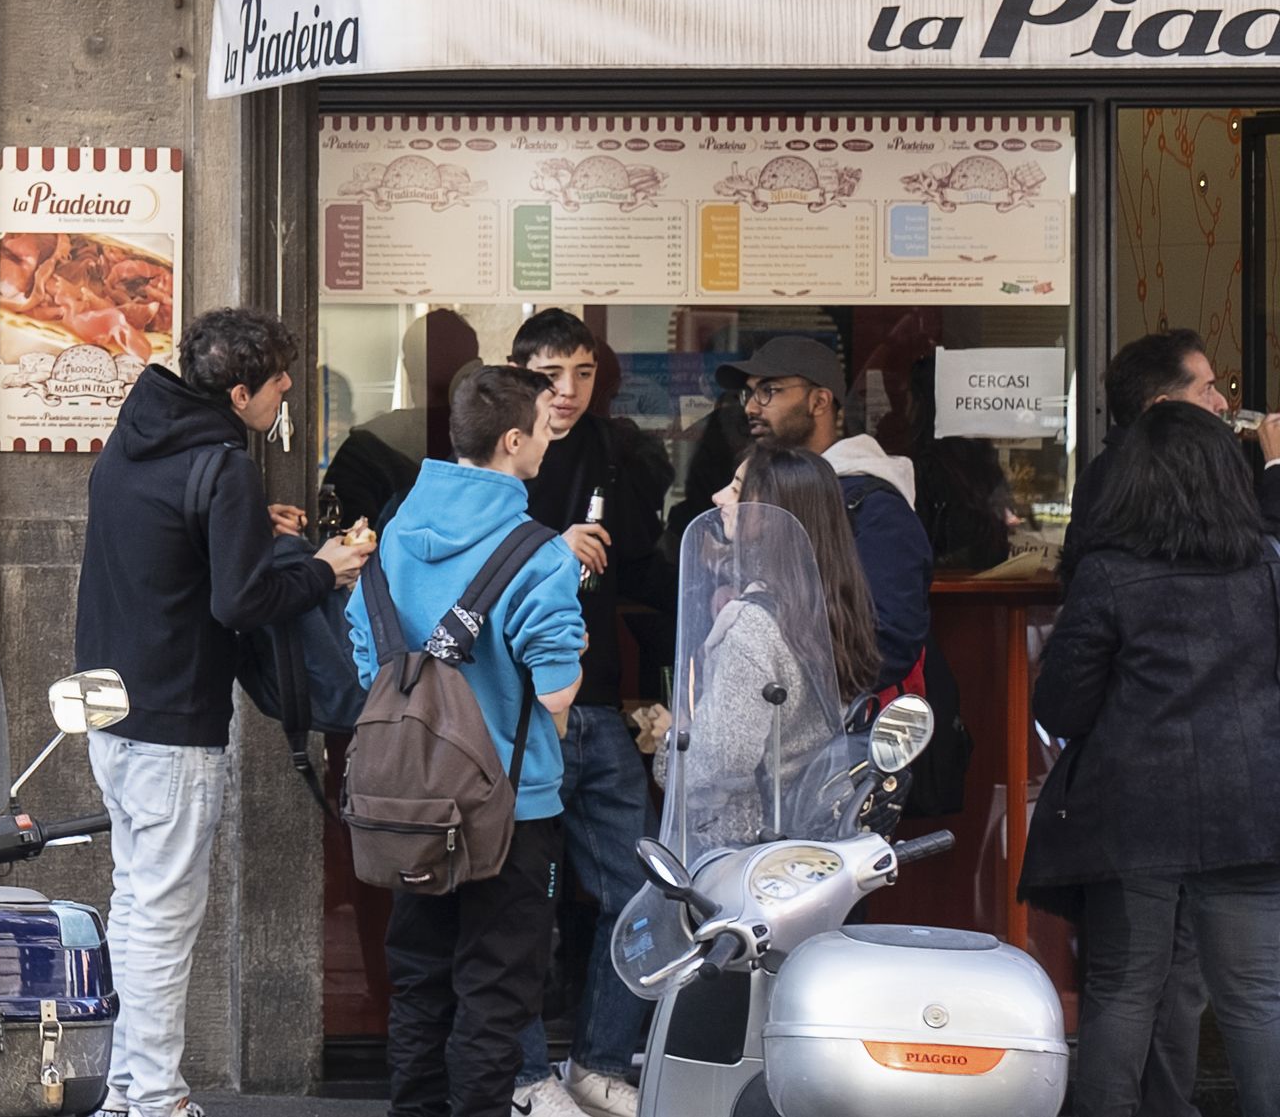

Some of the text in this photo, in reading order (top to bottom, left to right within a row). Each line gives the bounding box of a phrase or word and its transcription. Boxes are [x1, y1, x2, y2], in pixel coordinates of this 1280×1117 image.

[867, 5, 964, 52] la
[224, 42, 239, 84] la
[328, 135, 370, 150] Piadeina
[516, 136, 558, 150] Piadeina
[704, 136, 747, 151] Piadeina
[893, 136, 935, 151] Piadeina
[12, 181, 132, 215] la Piadeina
[384, 189, 439, 200] Tradizionali
[968, 374, 1030, 388] CERCASI
[54, 384, 116, 394] MADE IN ITALY
[955, 396, 1043, 411] PERSONALE
[905, 1052, 968, 1066] PIAGGIO
